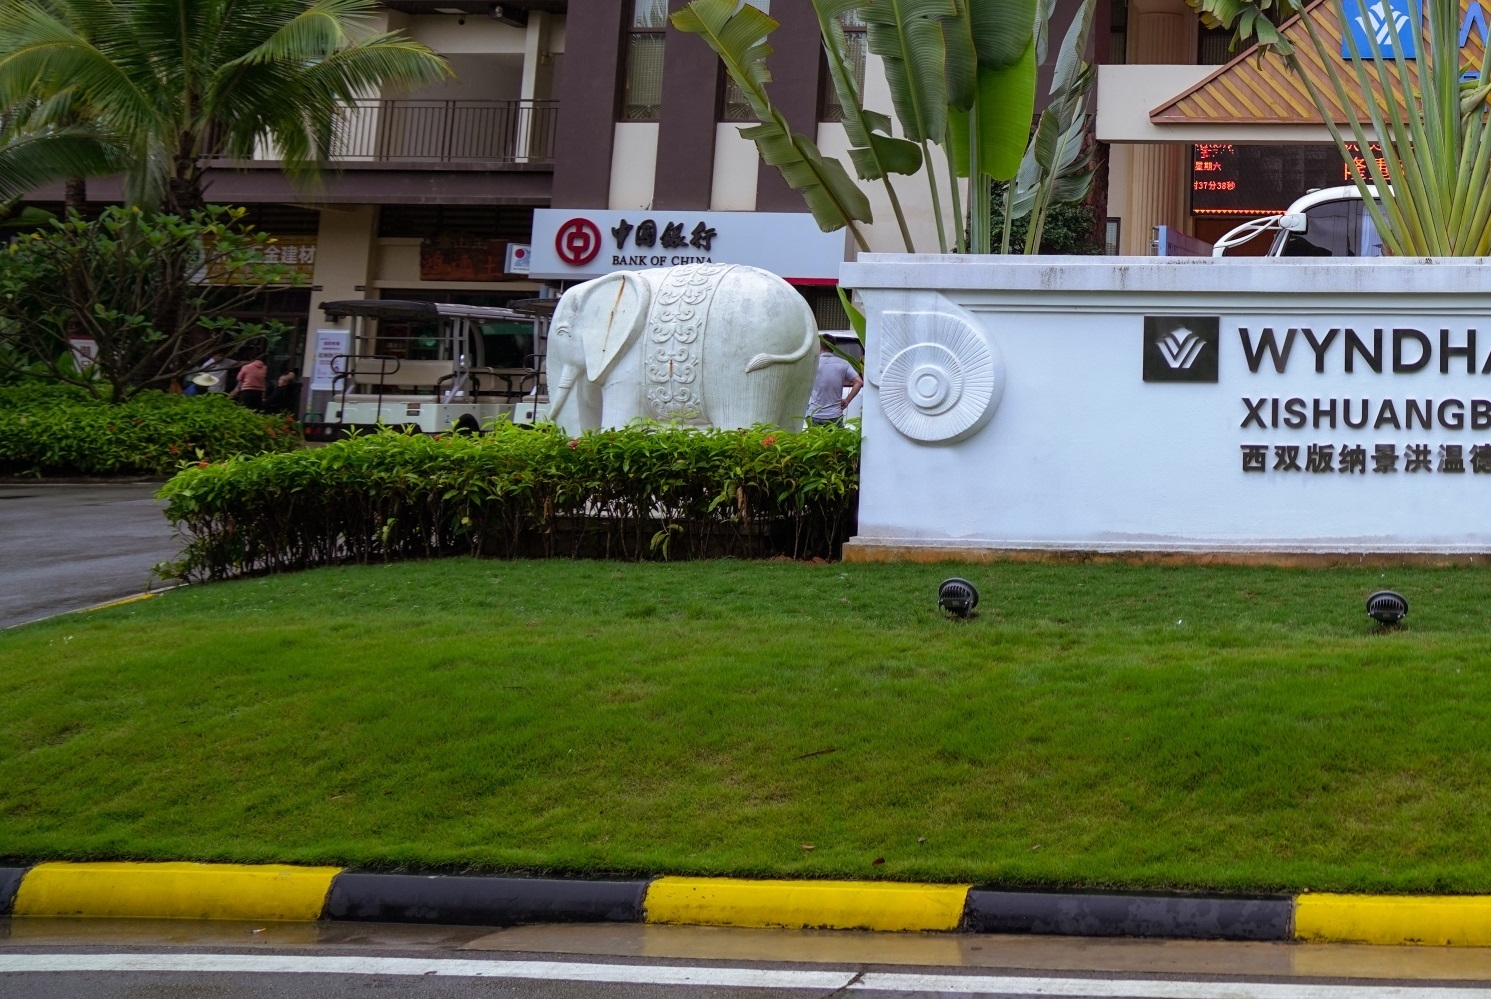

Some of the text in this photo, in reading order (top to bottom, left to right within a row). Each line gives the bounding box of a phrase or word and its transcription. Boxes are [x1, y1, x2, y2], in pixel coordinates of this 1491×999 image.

[1195, 161, 1222, 171] 星期六
[611, 218, 718, 251] 中国银行
[612, 255, 712, 266] BANK OF CHINA
